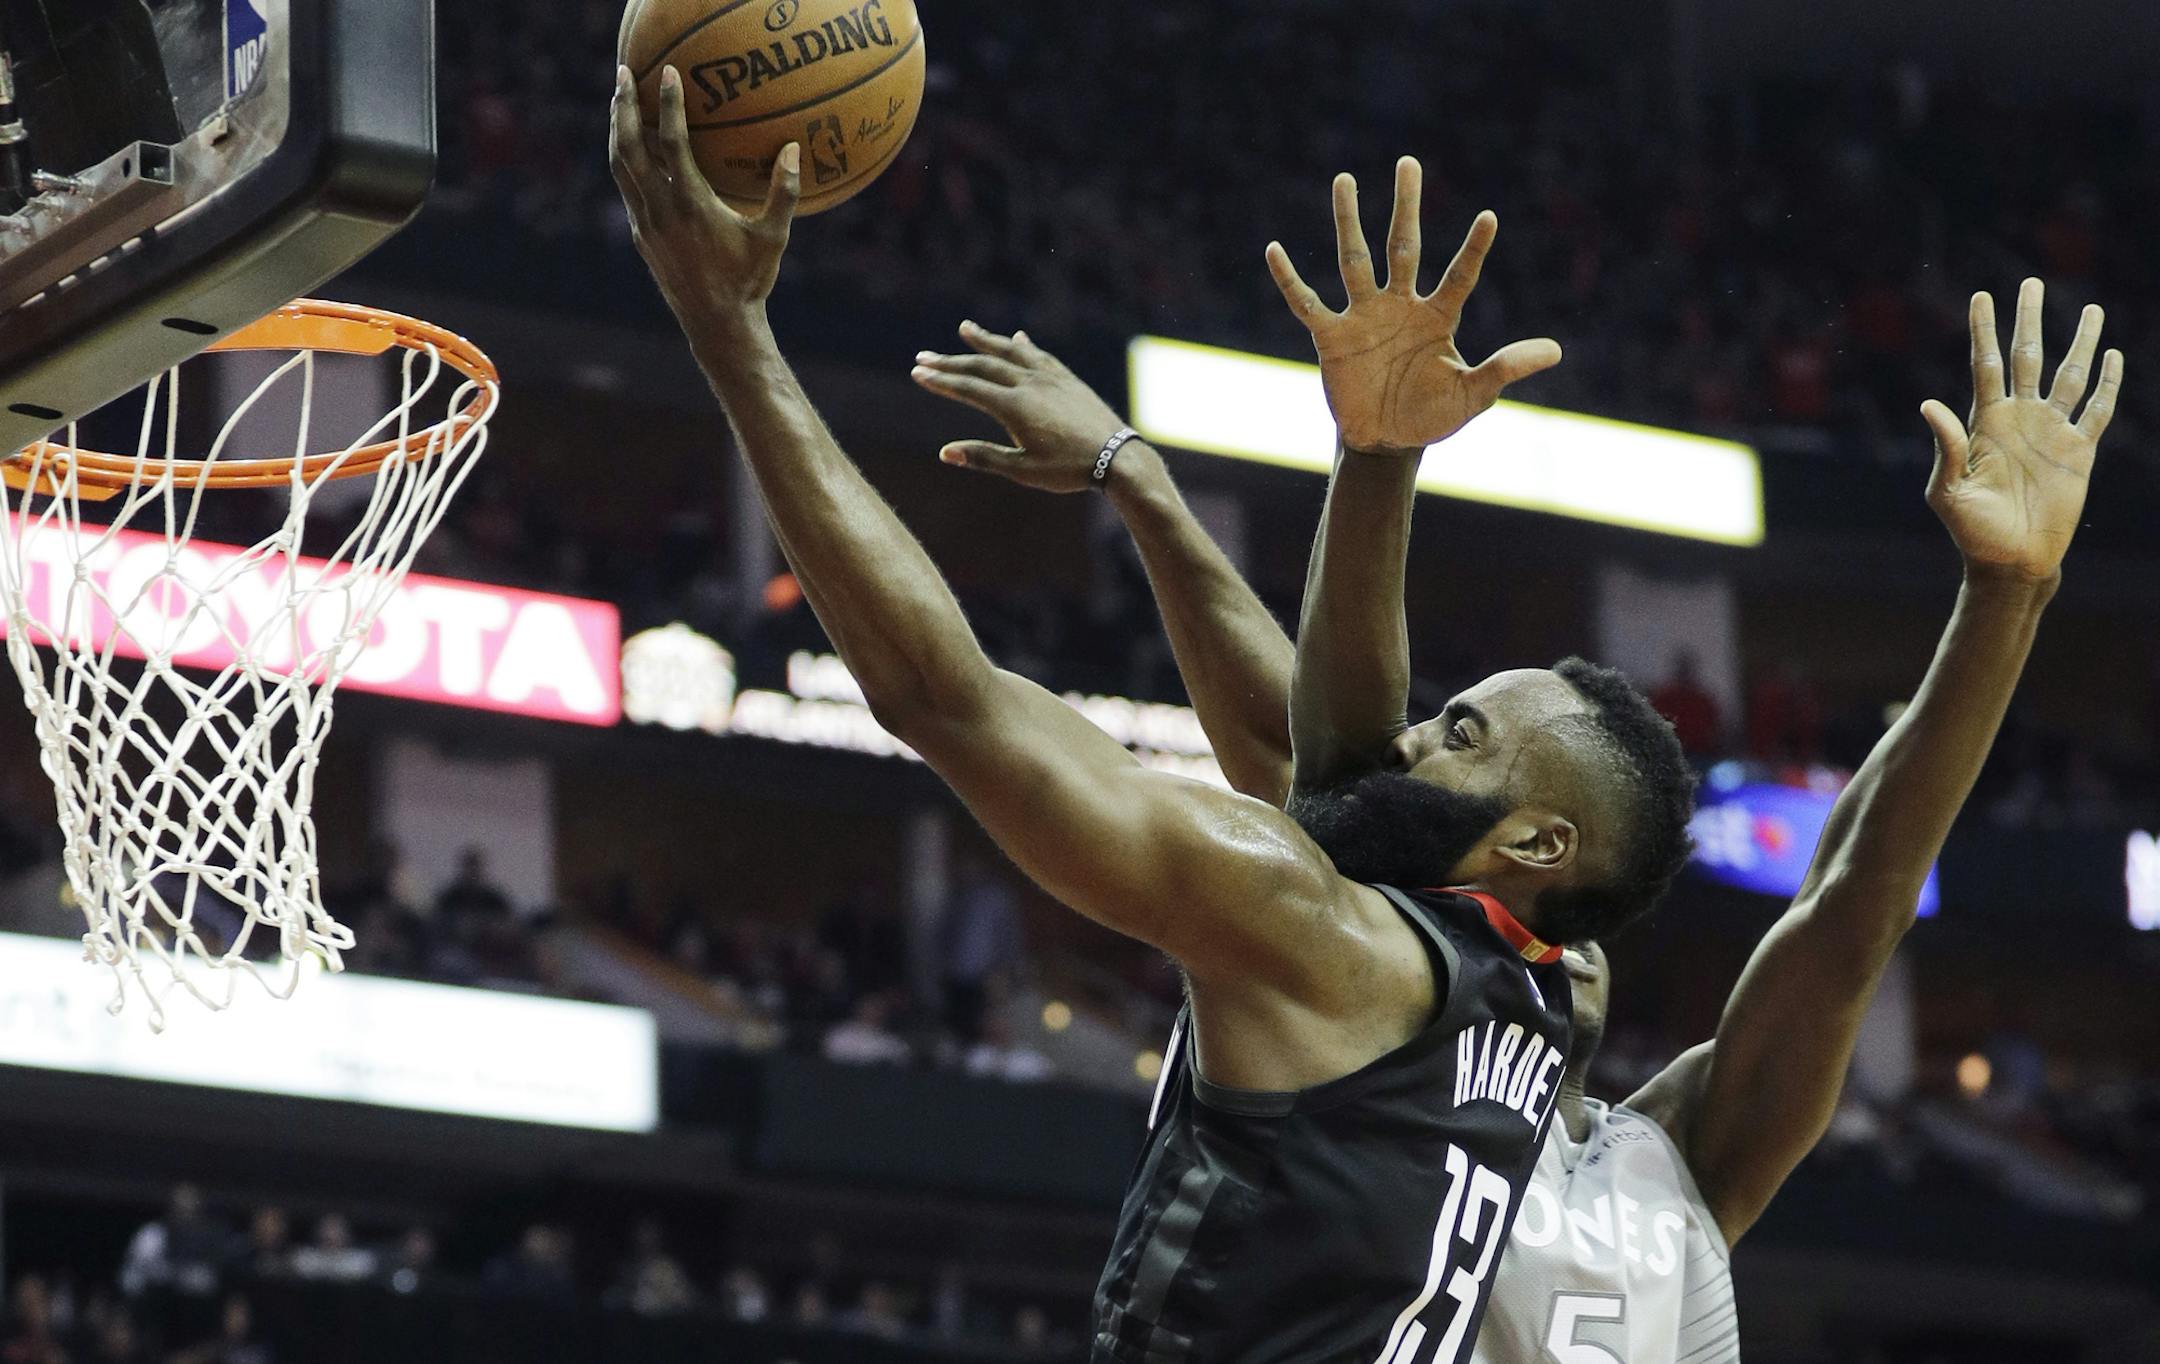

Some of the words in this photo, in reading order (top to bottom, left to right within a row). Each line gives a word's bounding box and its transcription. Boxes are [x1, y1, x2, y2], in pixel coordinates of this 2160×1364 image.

[689, 0, 894, 114] SPALDING
[22, 525, 610, 715] TOYOTA
[1453, 1019, 1567, 1144] HARDE
[1374, 1142, 1512, 1364] 13
[1511, 1182, 1686, 1277] ONES
[1545, 1290, 1627, 1364] 5
